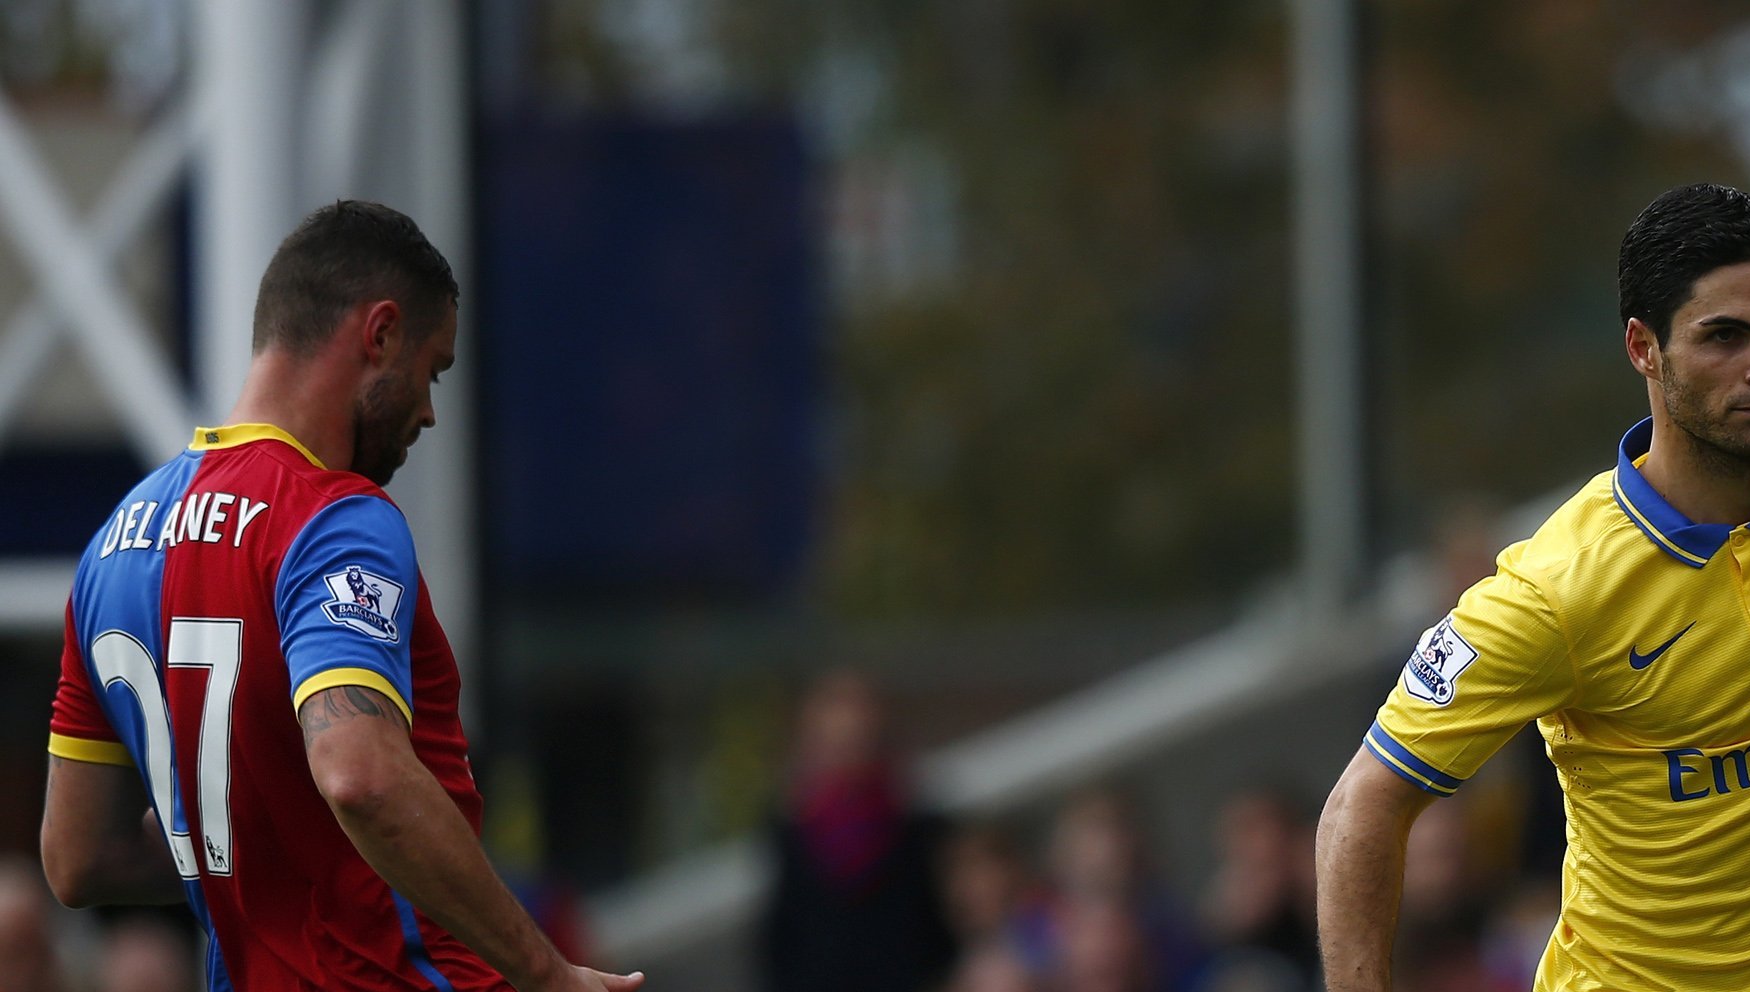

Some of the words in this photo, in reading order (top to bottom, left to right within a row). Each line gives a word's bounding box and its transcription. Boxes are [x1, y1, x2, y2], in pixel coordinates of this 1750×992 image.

[100, 491, 269, 560] DELANEY
[339, 605, 384, 626] BARCLAYS
[92, 617, 243, 881] 27
